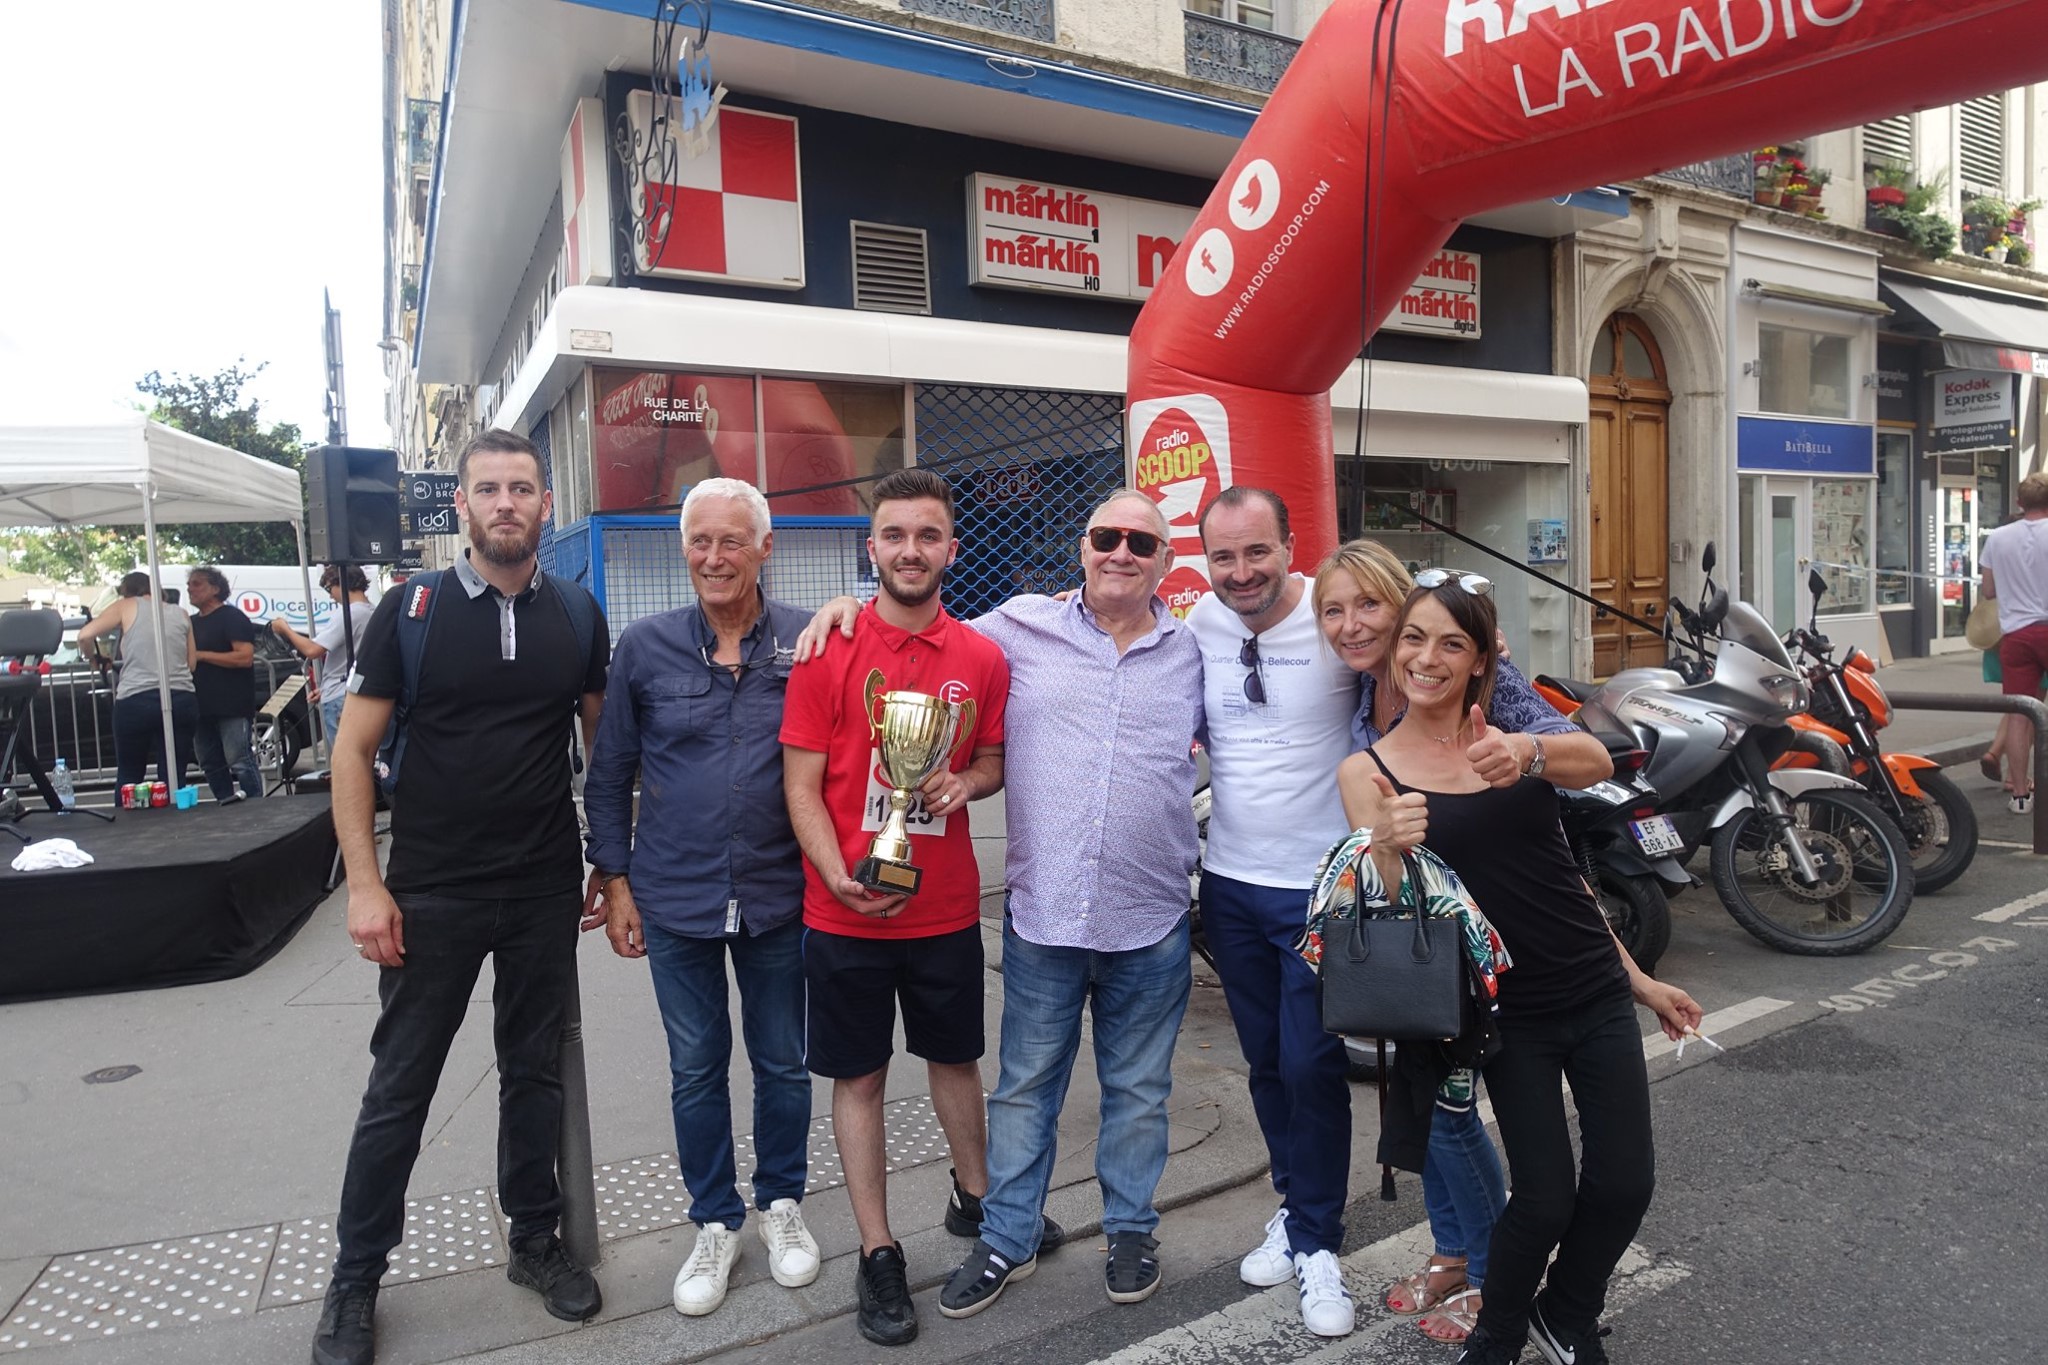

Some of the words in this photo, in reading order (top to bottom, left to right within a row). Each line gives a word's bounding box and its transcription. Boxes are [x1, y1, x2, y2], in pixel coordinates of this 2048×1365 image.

[1512, 47, 1604, 118] LA
[1091, 228, 1099, 243] 1
[1214, 180, 1331, 340] WWW.RADIOSCOOP.COM
[1944, 378, 1991, 394] Kodak
[644, 397, 668, 409] RUE
[673, 398, 689, 410] DE
[695, 400, 710, 410] LA
[1945, 392, 2001, 407] Express
[652, 410, 703, 422] CHARITE
[1941, 424, 2004, 436] Photographes
[1156, 428, 1190, 451] radio
[1137, 442, 1210, 489] SCOOP
[1168, 587, 1201, 608] radio
[243, 598, 260, 613] U
[271, 598, 339, 612] locaion
[1235, 656, 1311, 667] C-Bellecour
